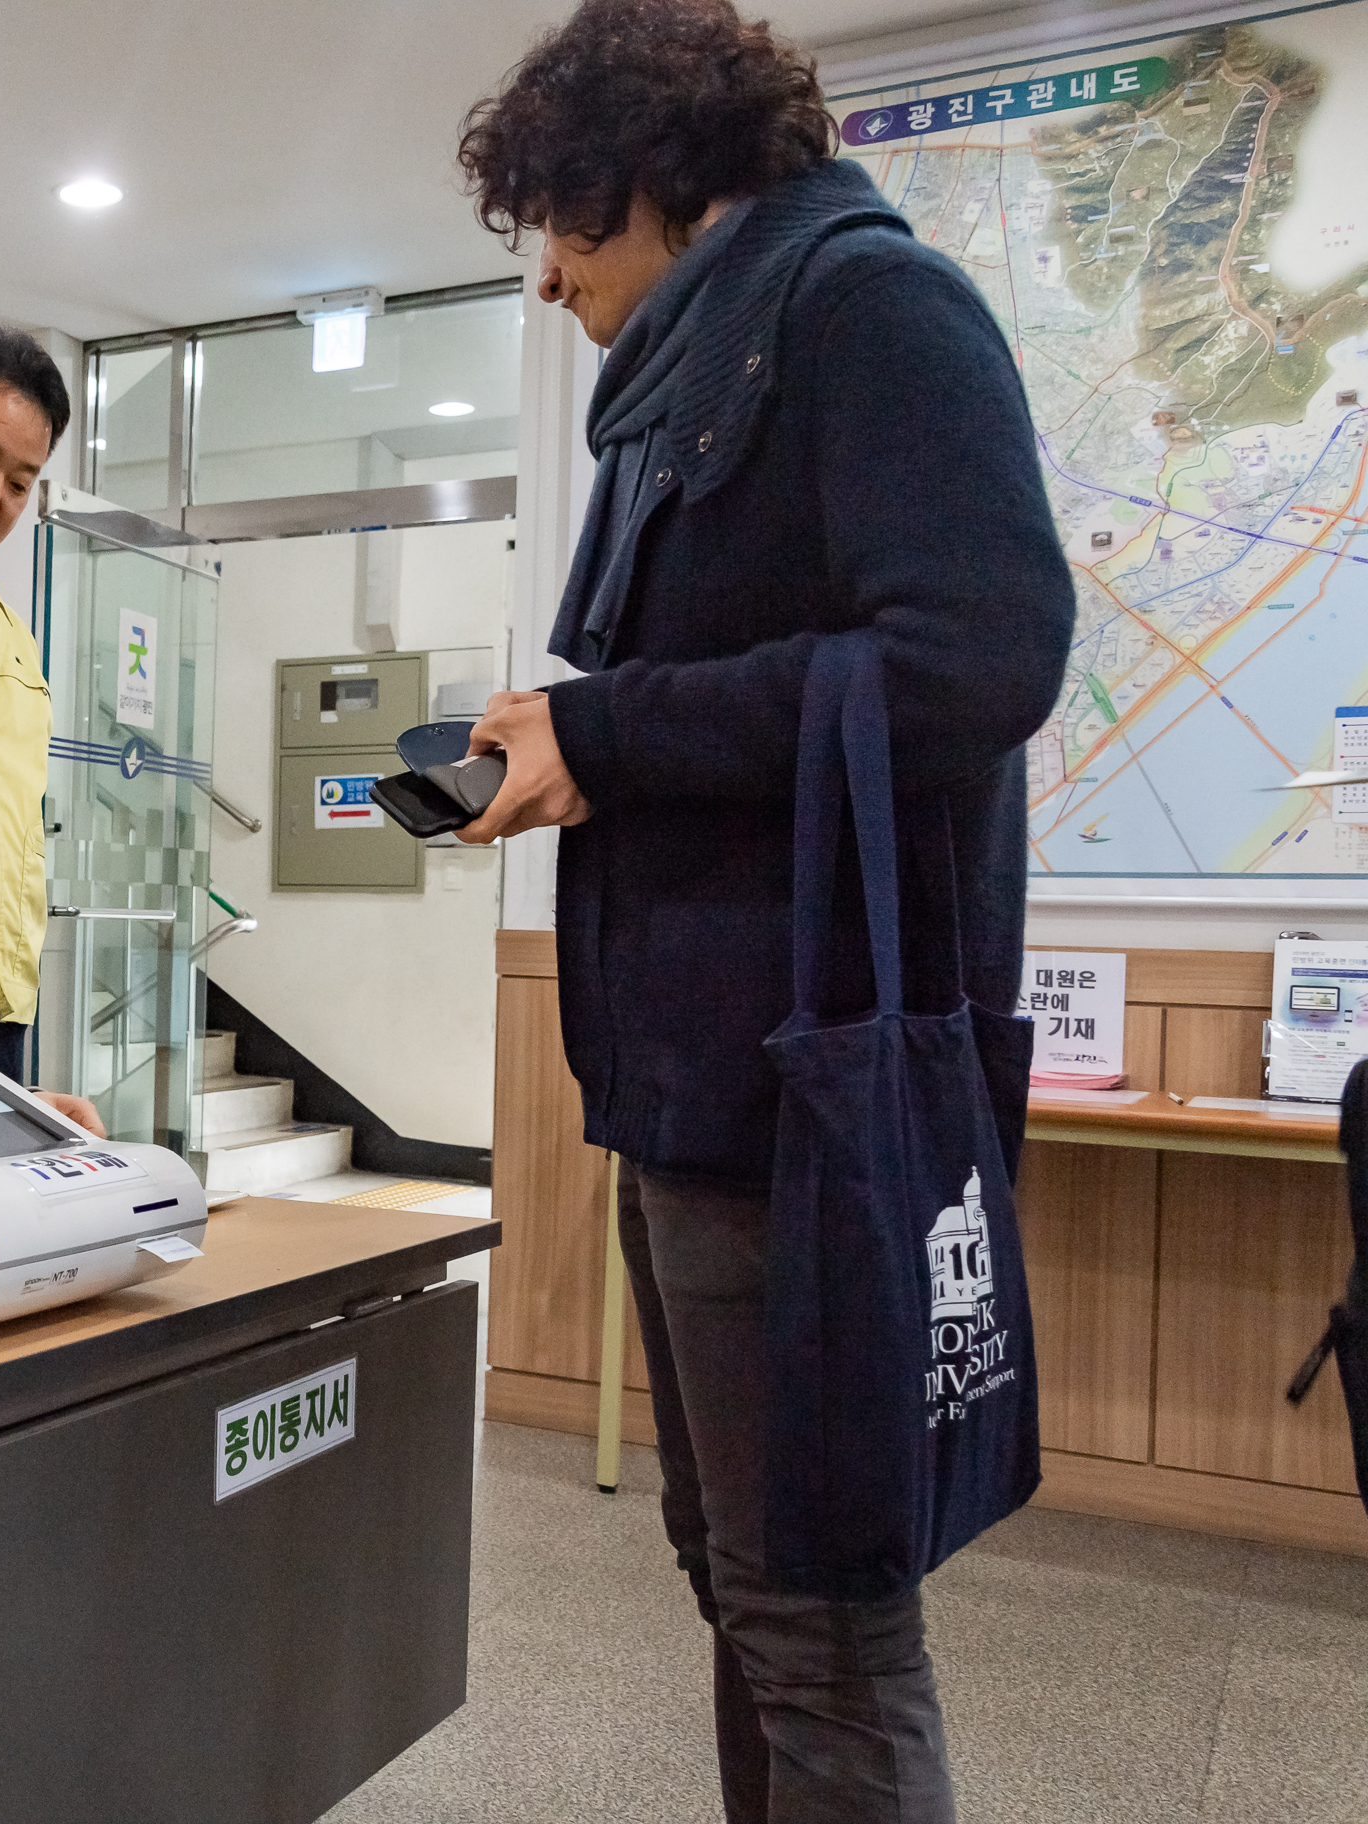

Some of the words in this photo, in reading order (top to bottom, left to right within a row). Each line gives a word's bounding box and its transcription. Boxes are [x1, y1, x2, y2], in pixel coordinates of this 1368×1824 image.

[1036, 969, 1097, 989] 대원은
[1048, 1017, 1095, 1040] 기재
[224, 1372, 351, 1478] 종이통지서
